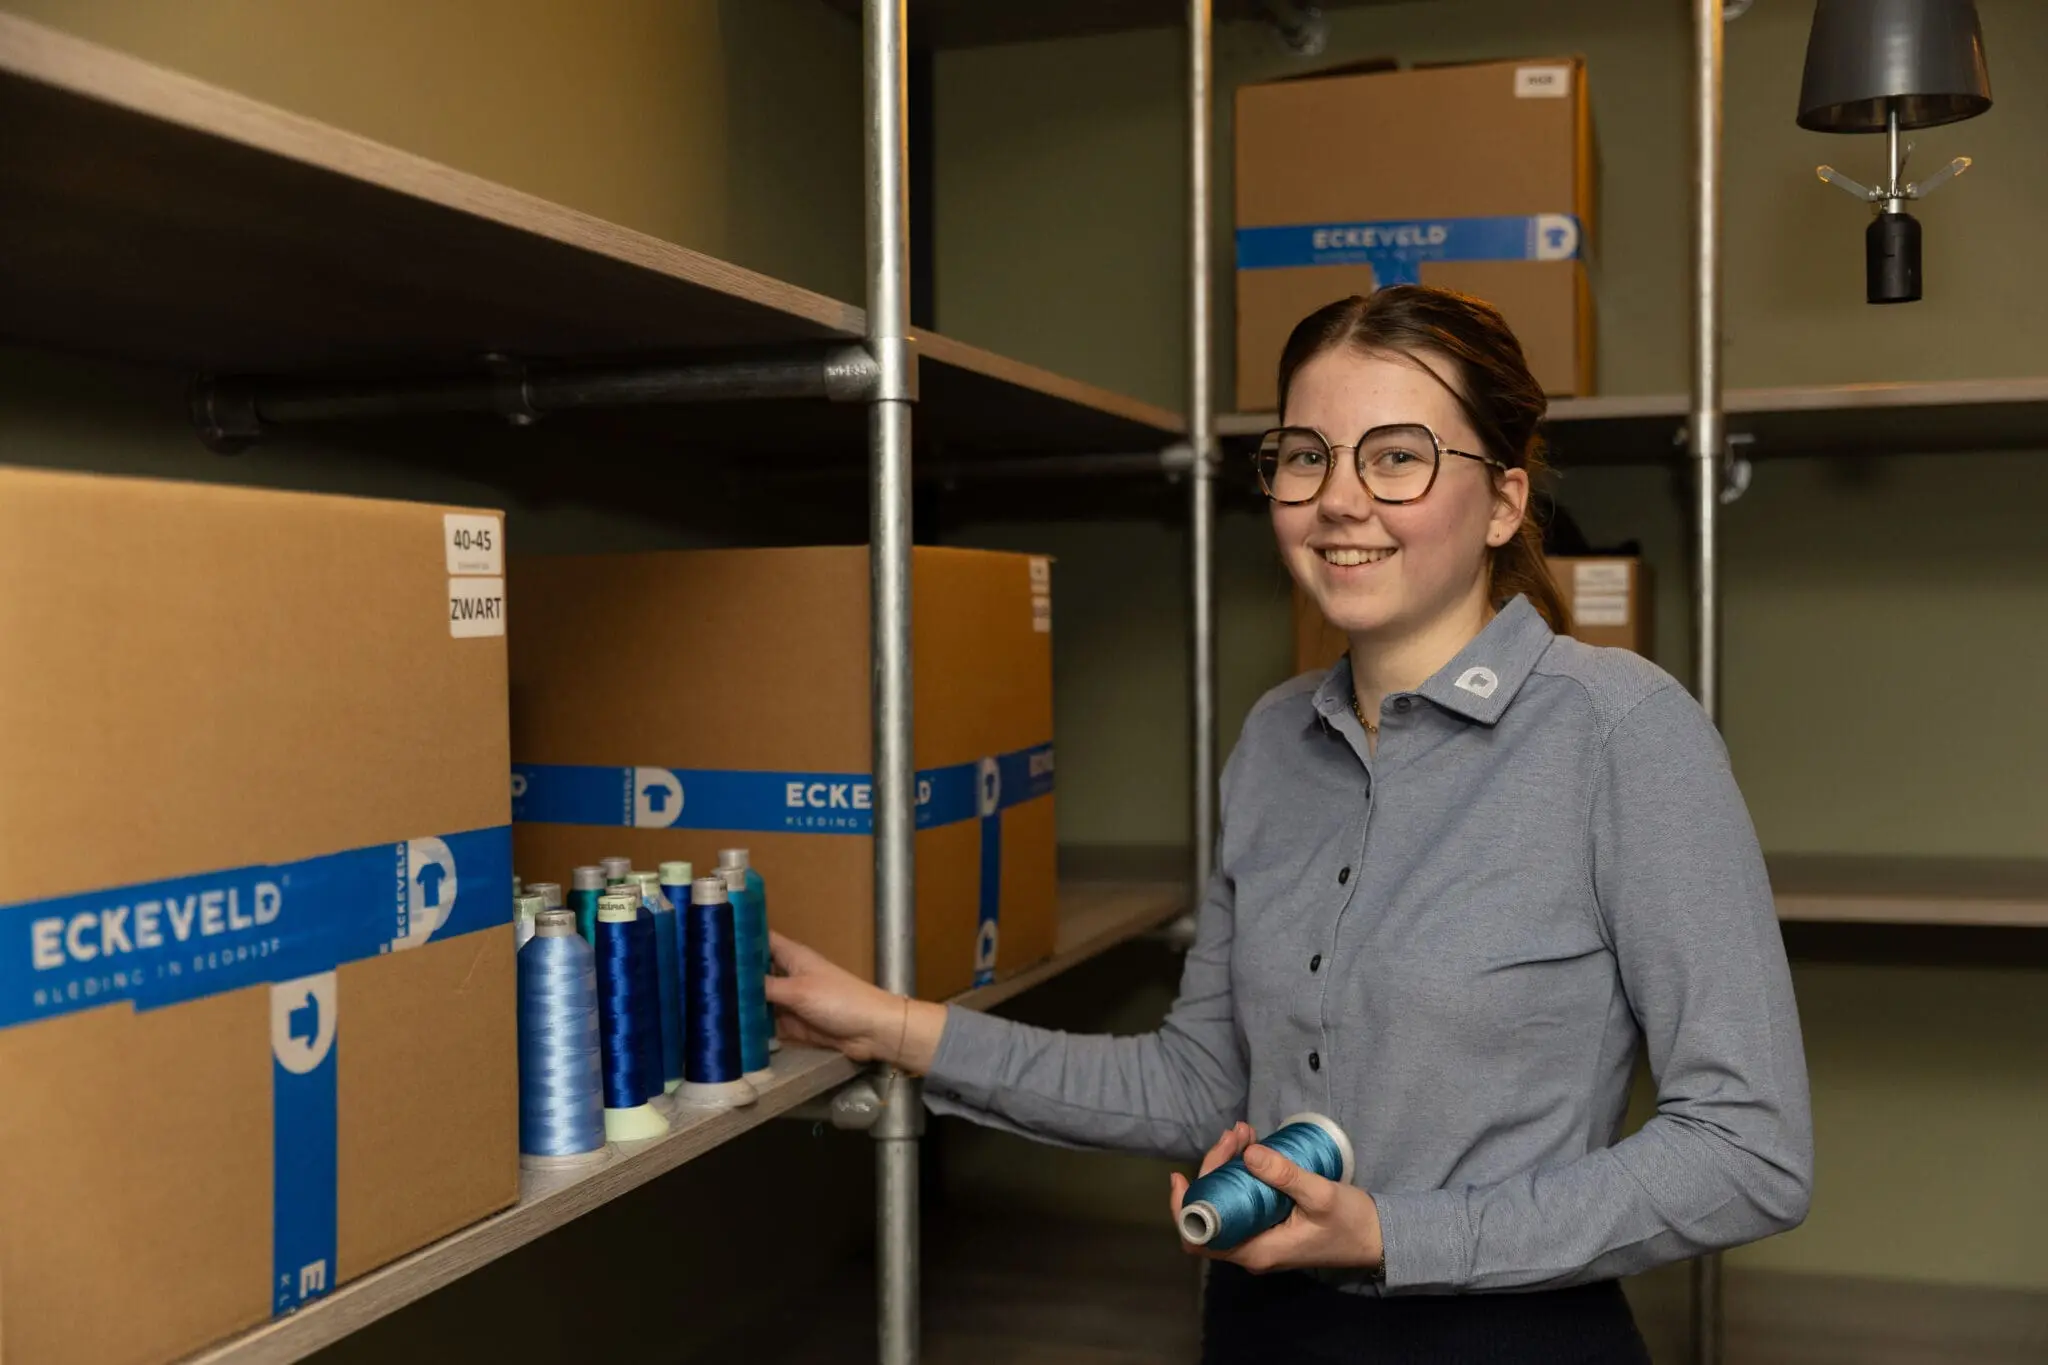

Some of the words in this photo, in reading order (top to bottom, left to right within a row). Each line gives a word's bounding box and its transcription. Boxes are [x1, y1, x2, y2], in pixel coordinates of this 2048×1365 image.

[1313, 225, 1448, 249] ECKEVELD
[454, 529, 492, 551] 40-45
[451, 598, 502, 620] ZWART
[31, 881, 282, 971] ECKEVELD
